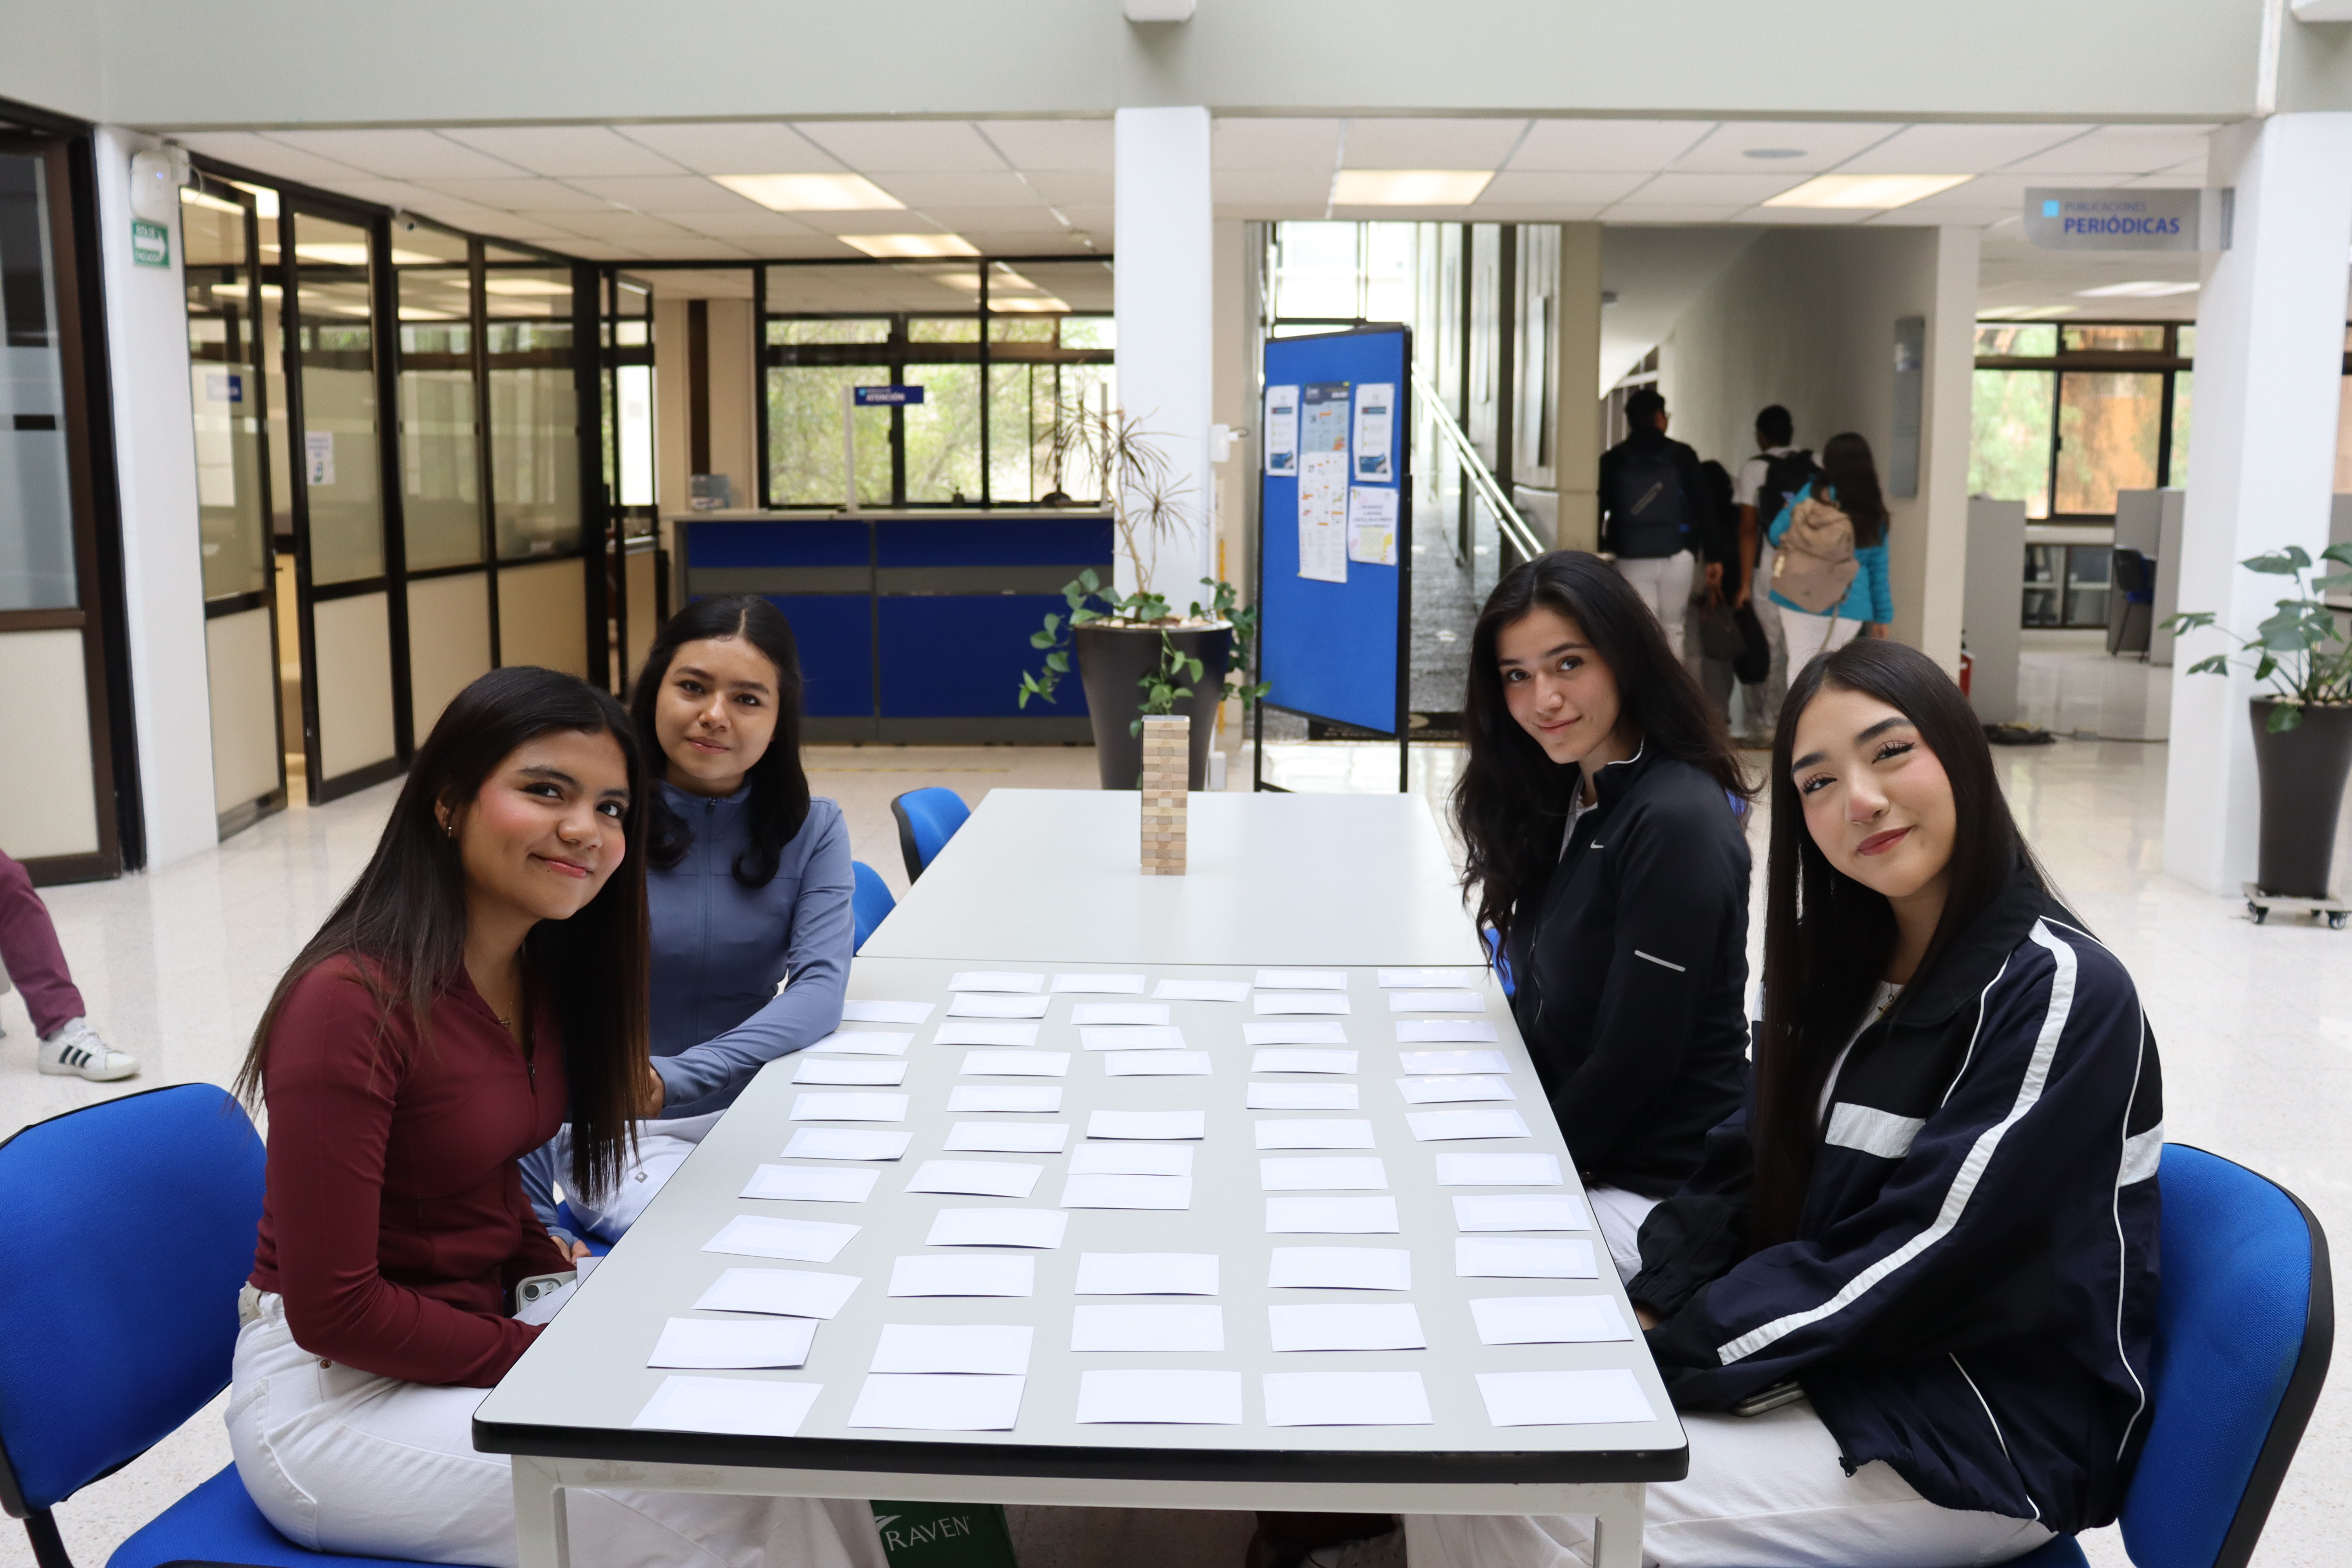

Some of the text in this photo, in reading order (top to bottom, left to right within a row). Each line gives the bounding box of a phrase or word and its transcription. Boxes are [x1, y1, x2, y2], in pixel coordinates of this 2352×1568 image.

[2064, 201, 2147, 212] PUBLICACIONES
[2064, 215, 2180, 234] PERIÓDICAS
[885, 1516, 970, 1551] RAVEN
